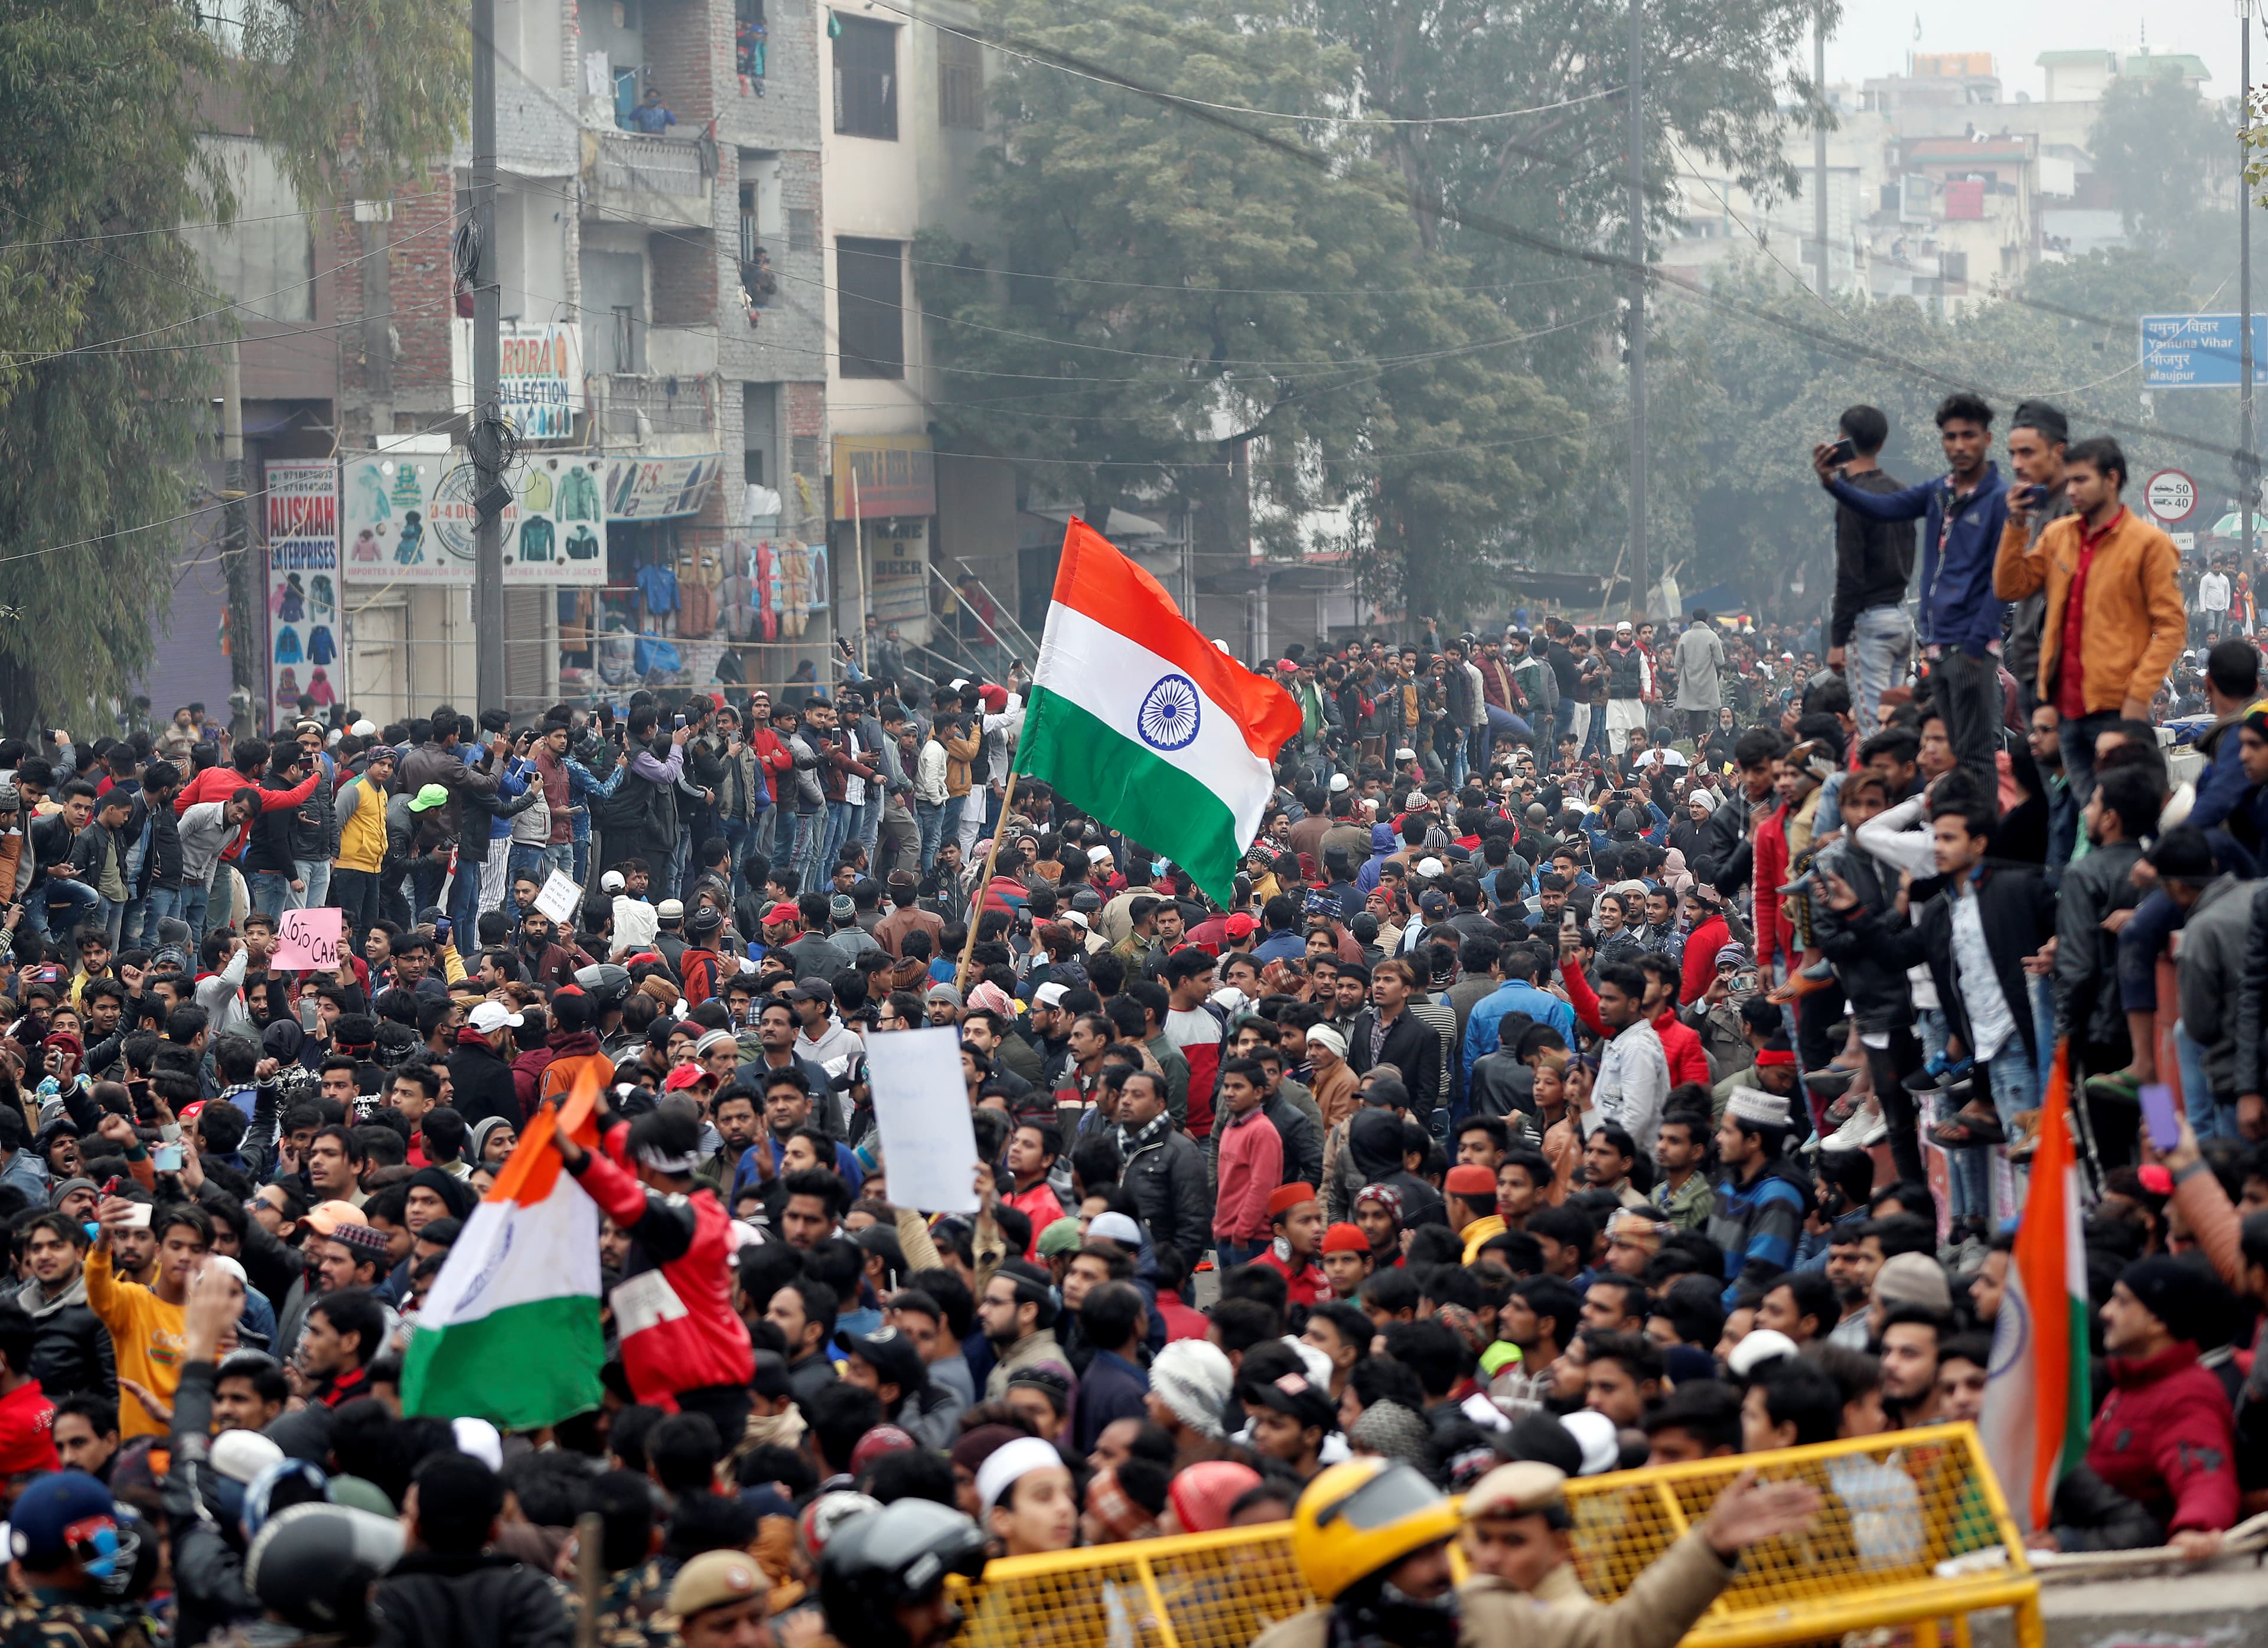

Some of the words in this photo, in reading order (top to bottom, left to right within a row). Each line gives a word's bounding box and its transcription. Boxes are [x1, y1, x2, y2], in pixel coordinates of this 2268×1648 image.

[2148, 338, 2197, 348] Yamuna
[2201, 337, 2233, 348] Vihar
[2150, 370, 2195, 383] Maujpur
[2175, 484, 2189, 494] 50
[2175, 498, 2188, 508] 40
[271, 496, 335, 537] ALISHAH
[878, 524, 923, 539] WINE
[271, 539, 336, 570] ENTERPRISES
[894, 542, 904, 556] &
[348, 567, 385, 576] IMPORTER
[876, 560, 922, 575] BEER
[279, 913, 299, 941] NO
[312, 936, 335, 964] CAA
